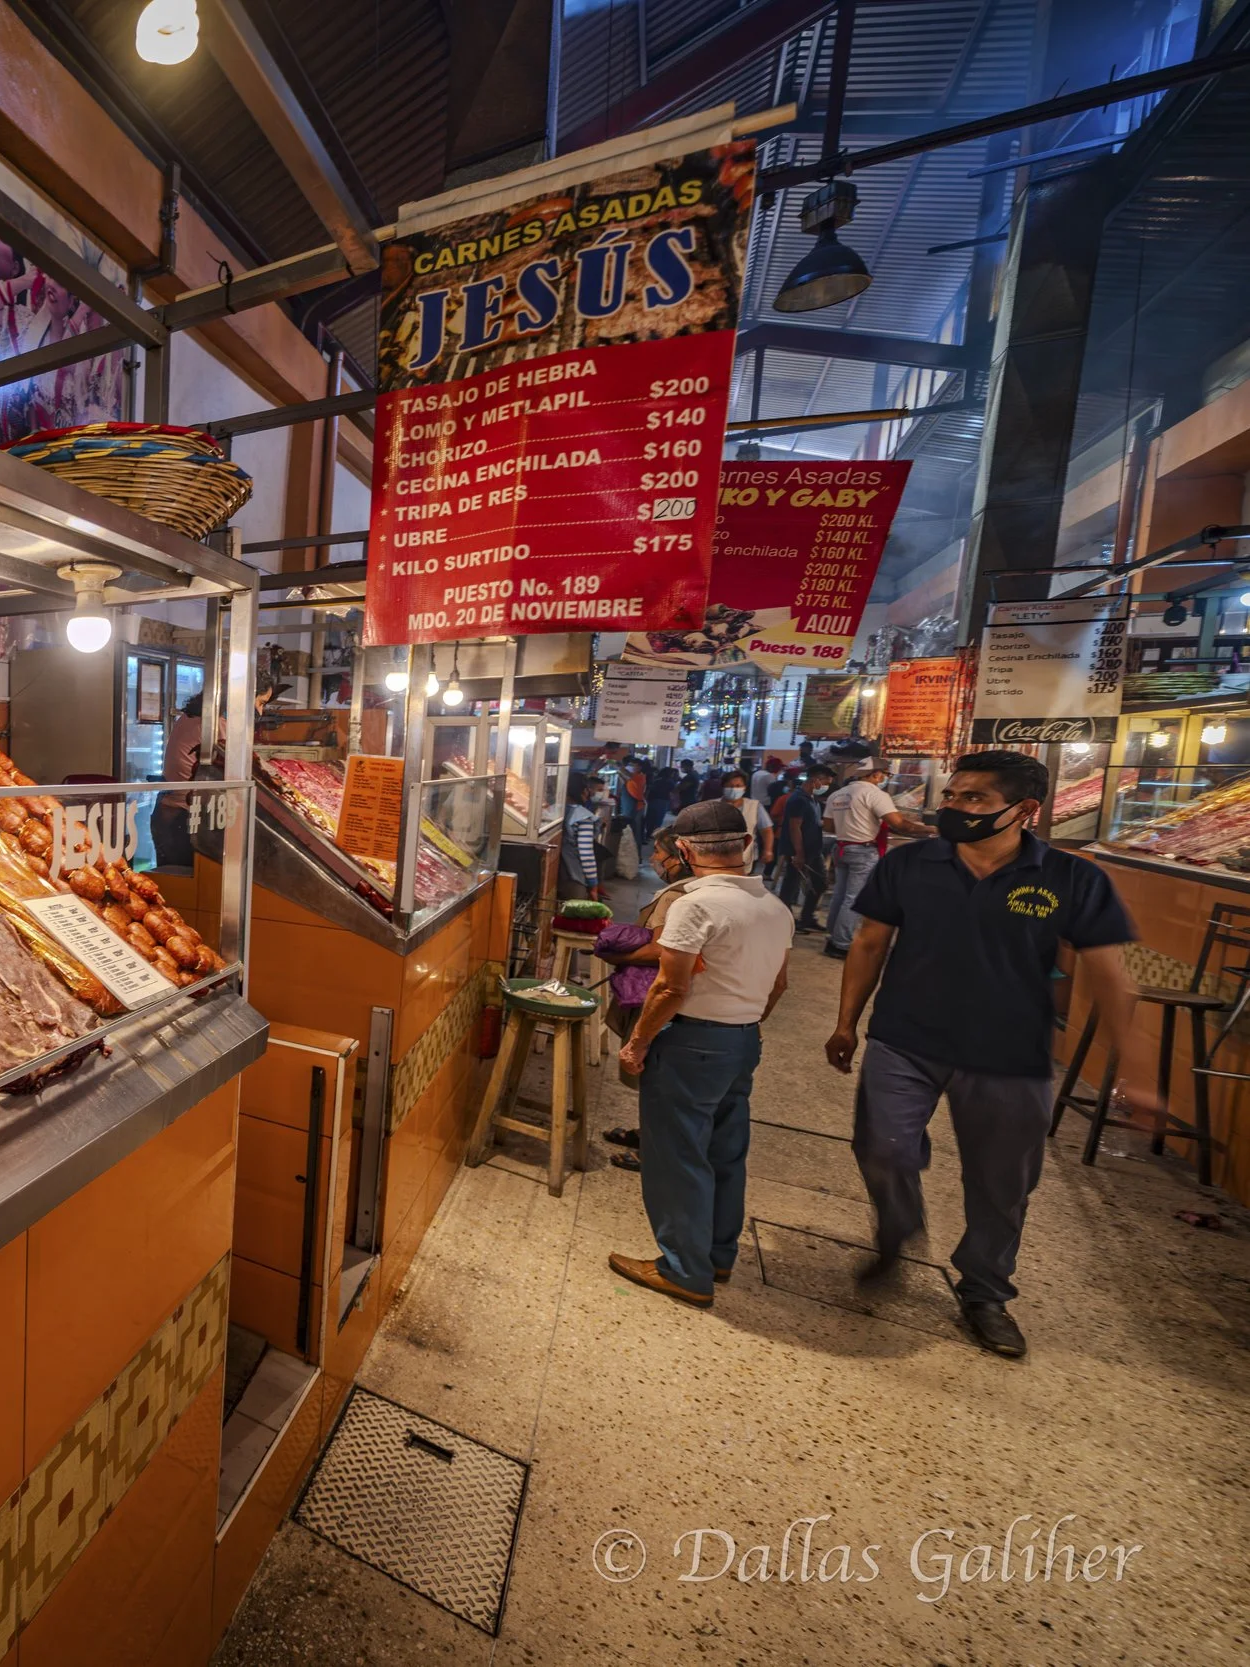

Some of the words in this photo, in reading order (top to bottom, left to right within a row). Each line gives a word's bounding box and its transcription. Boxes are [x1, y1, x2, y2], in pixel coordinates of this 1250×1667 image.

[414, 221, 543, 275] CARNES
[551, 179, 703, 238] ASADAS
[408, 227, 697, 371] JESÚS
[400, 387, 478, 415] TASAJO
[485, 376, 511, 398] DE
[517, 360, 597, 388] HEBRA
[649, 376, 709, 399] $200
[400, 420, 456, 442] LOMO
[463, 415, 475, 431] Y
[481, 390, 590, 427] METLAPIL
[646, 407, 706, 431] $140
[398, 439, 487, 468] CHORIZO
[643, 439, 702, 460] $160
[396, 472, 470, 495] CECINA
[476, 449, 601, 482] ENCHILADA
[640, 471, 698, 491] $200
[719, 471, 778, 484] arnes
[784, 467, 882, 484] Asadas
[395, 501, 452, 521] TRIPA
[458, 495, 482, 513] DE
[488, 485, 528, 506] RES
[765, 488, 786, 506] Y
[820, 514, 854, 527] $200
[857, 515, 878, 528] KL.
[394, 529, 448, 547] UBRE
[633, 534, 692, 555] $175
[815, 530, 850, 543] $140
[852, 531, 873, 544] KL.
[392, 559, 438, 576] KILO
[444, 544, 530, 571] SURTIDO
[724, 545, 798, 558] enchilada
[810, 547, 845, 560] $160
[849, 548, 868, 560] KL.
[804, 564, 840, 577] $200
[841, 565, 862, 578] KL.
[444, 579, 513, 605] PUESTO
[520, 578, 553, 596] No.
[561, 576, 600, 594] 189
[800, 578, 834, 592] $180
[836, 579, 857, 593] KL.
[795, 594, 830, 607] $175
[832, 595, 852, 609] KL.
[408, 611, 450, 630] MDO.
[456, 608, 476, 626] 20
[481, 604, 505, 623] DE
[511, 597, 643, 621] NOVIEMBRE
[803, 614, 852, 634] AQUI
[991, 632, 1025, 640] Tasajo
[749, 639, 805, 656] Puesto
[812, 643, 843, 659] 188
[990, 643, 1030, 651] Chorizo
[1027, 652, 1080, 661] Enchilada
[49, 801, 140, 882] JESUS
[189, 795, 201, 834] #
[206, 794, 238, 830] 189
